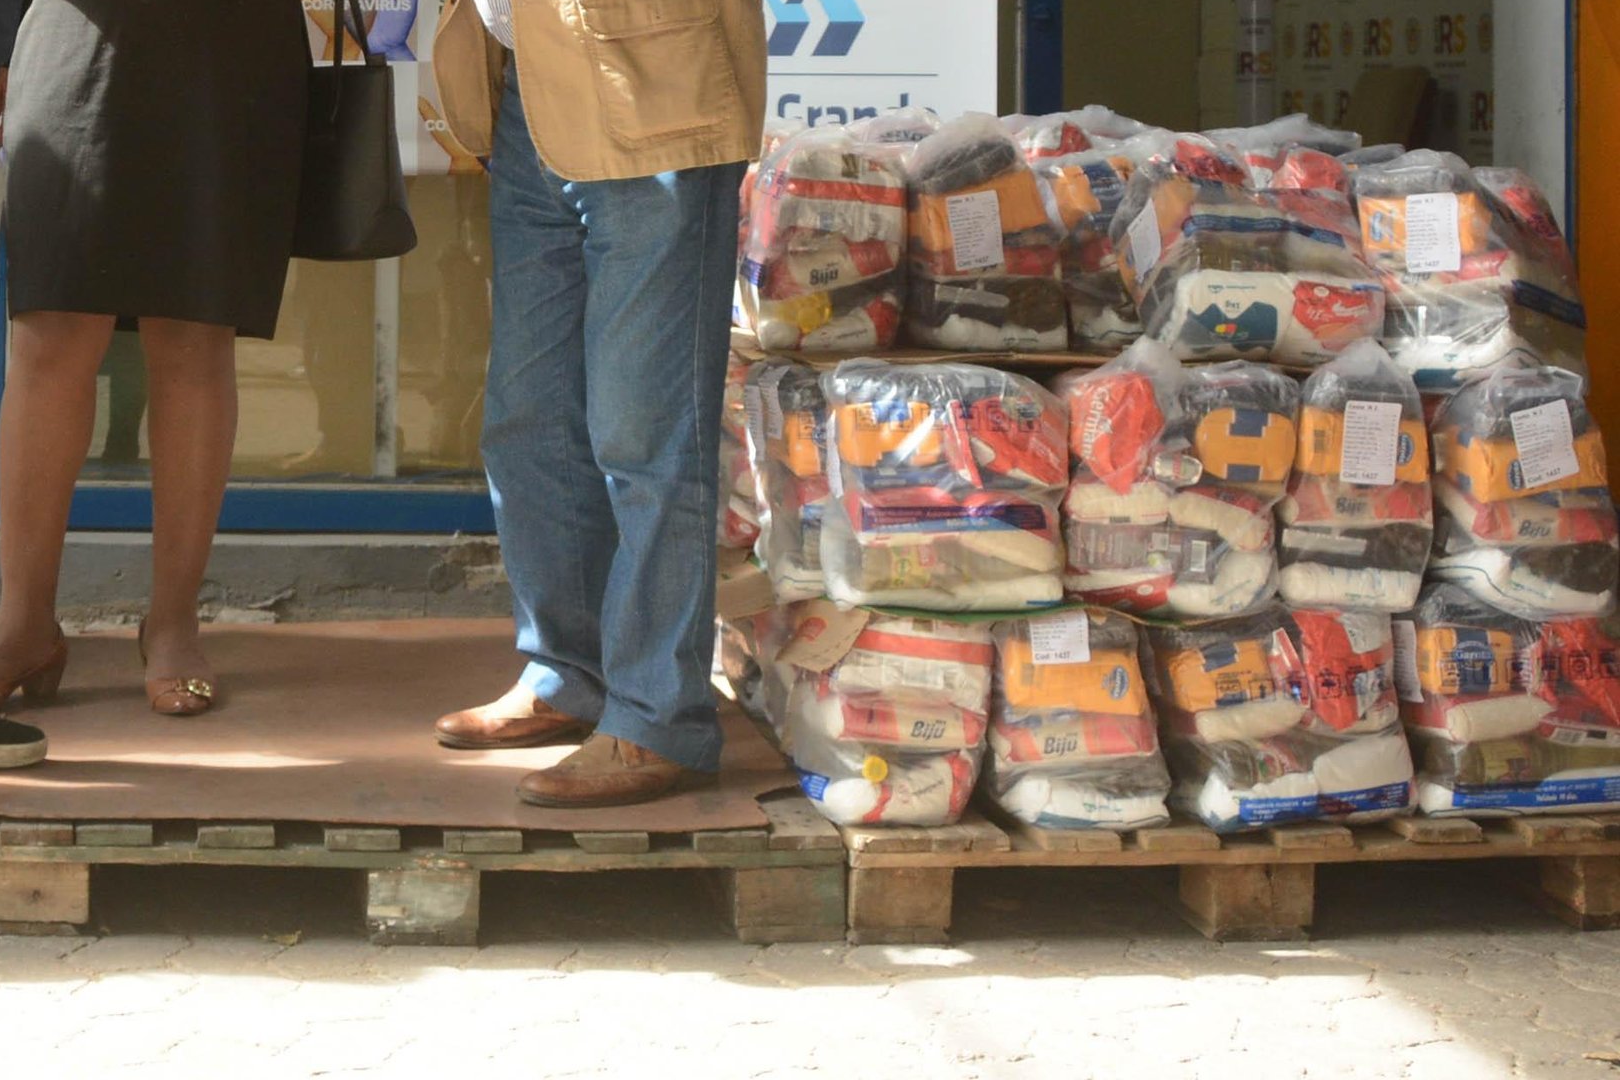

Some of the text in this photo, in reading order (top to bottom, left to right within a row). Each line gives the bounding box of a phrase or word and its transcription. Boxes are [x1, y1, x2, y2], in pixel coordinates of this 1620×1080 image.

[810, 265, 839, 286] Biju
[910, 719, 947, 741] Biju
[1044, 735, 1078, 757] Biju
